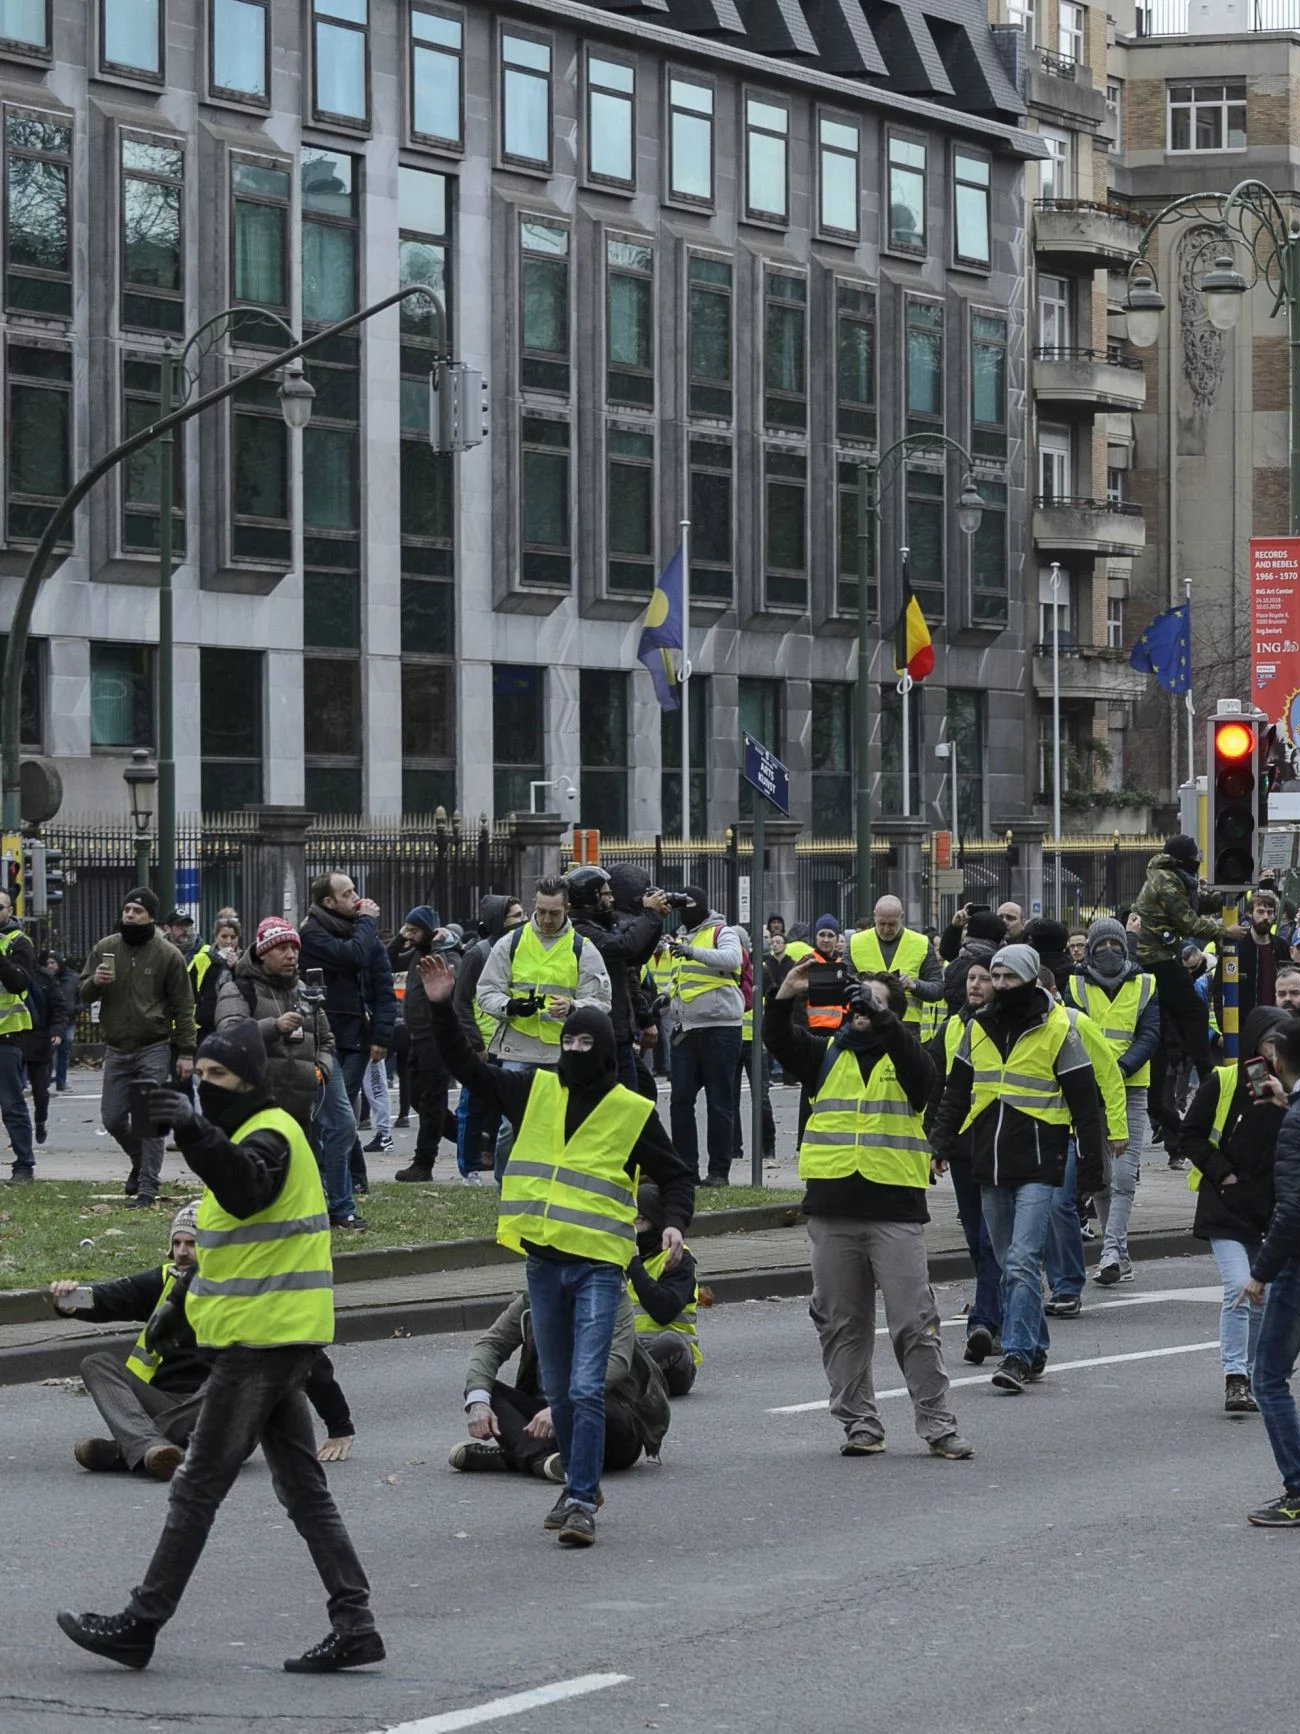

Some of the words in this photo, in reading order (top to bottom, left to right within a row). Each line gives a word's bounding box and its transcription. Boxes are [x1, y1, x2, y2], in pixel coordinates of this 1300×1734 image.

[1255, 550, 1288, 559] RECORDS
[1255, 561, 1271, 569] AND
[1272, 560, 1298, 568] REBELS
[1255, 572, 1274, 581] 1966
[1280, 572, 1298, 580] 1970
[1256, 642, 1281, 653] ING
[760, 762, 774, 781] ARTS
[758, 772, 776, 794] KUNST
